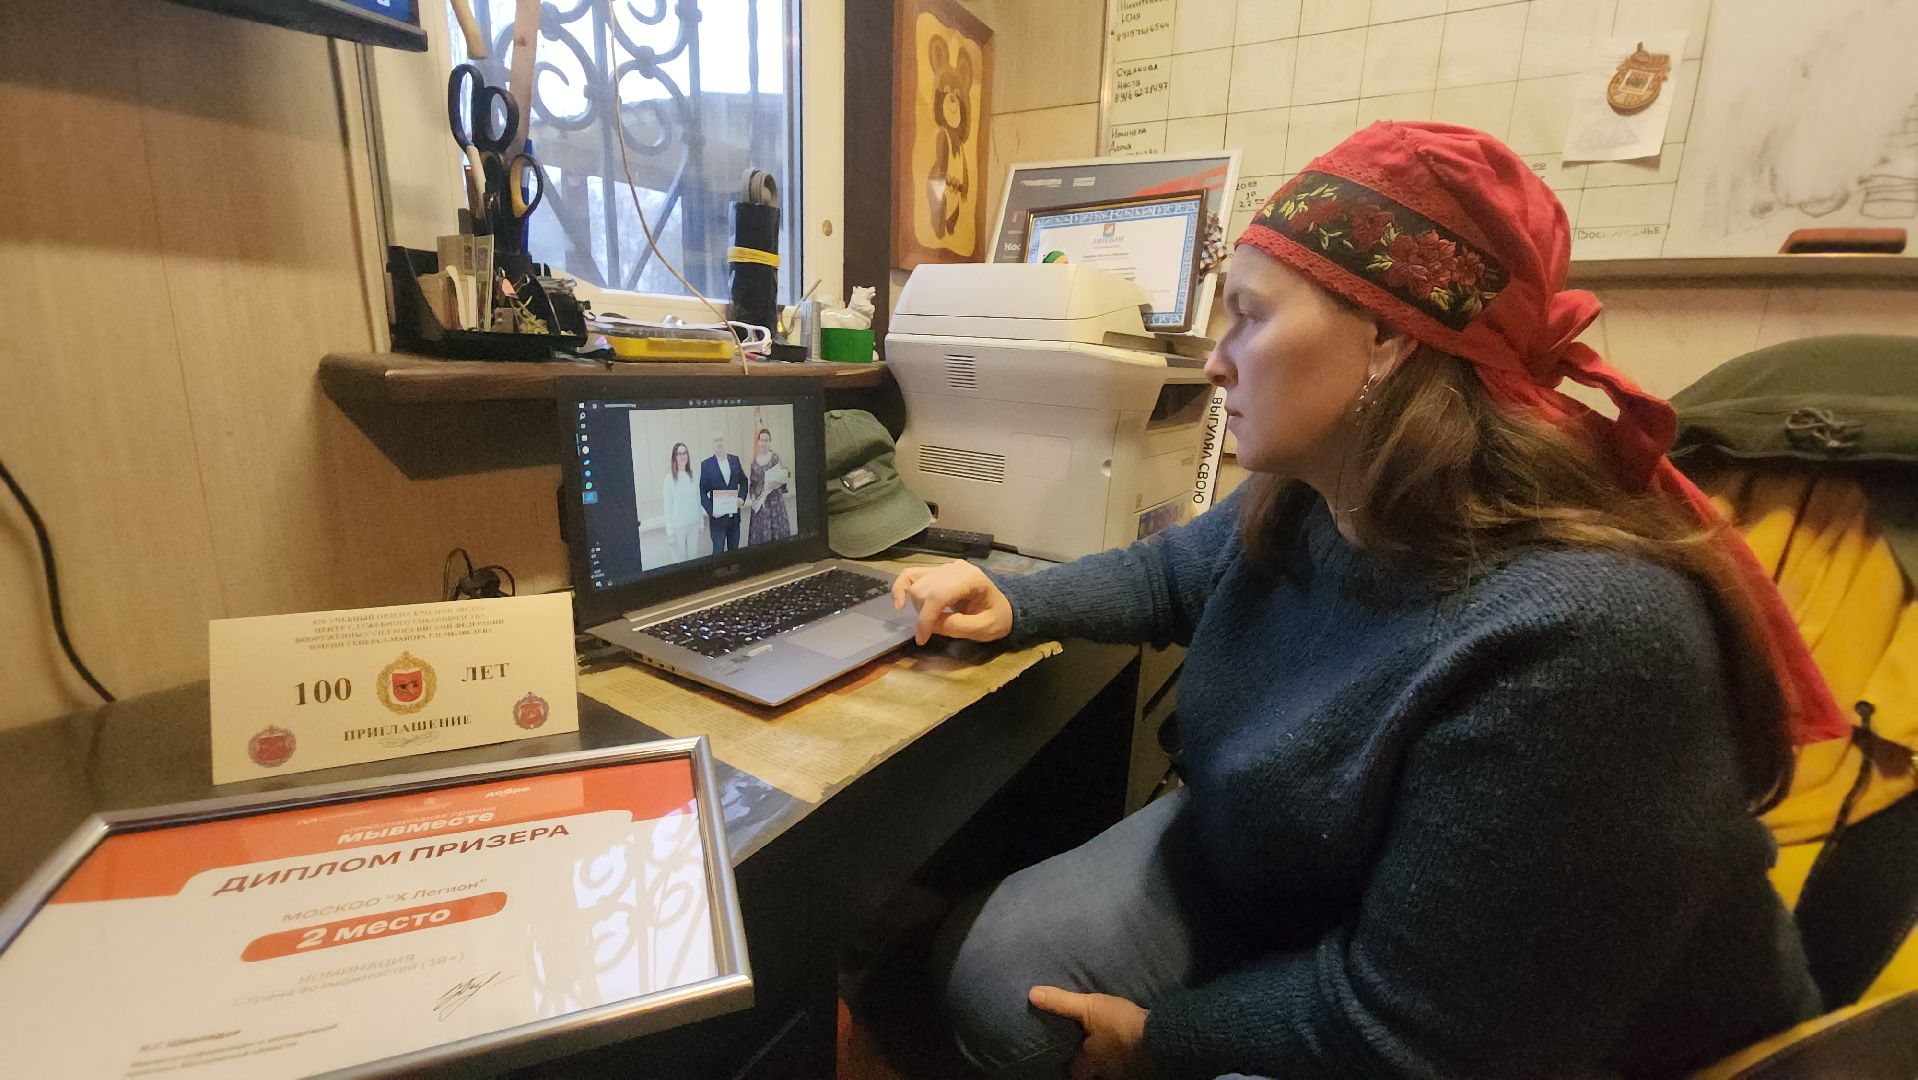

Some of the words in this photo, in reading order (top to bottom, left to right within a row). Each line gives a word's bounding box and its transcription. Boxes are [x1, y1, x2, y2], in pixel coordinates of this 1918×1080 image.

[1201, 397, 1223, 460] ВЫГУЛЯЛ
[1192, 462, 1211, 504] СВОЮ
[294, 677, 353, 706] 100
[461, 662, 510, 683] ЛЕТ
[343, 714, 472, 743] ПРИГЛАШЕНИЕ
[212, 851, 401, 897] ДИПЛОМ
[408, 824, 571, 862] ПРИЗЕРА
[281, 896, 381, 924] МОСКОО
[296, 927, 328, 950] 2
[298, 953, 417, 985] НОМИНАЦИЯ
